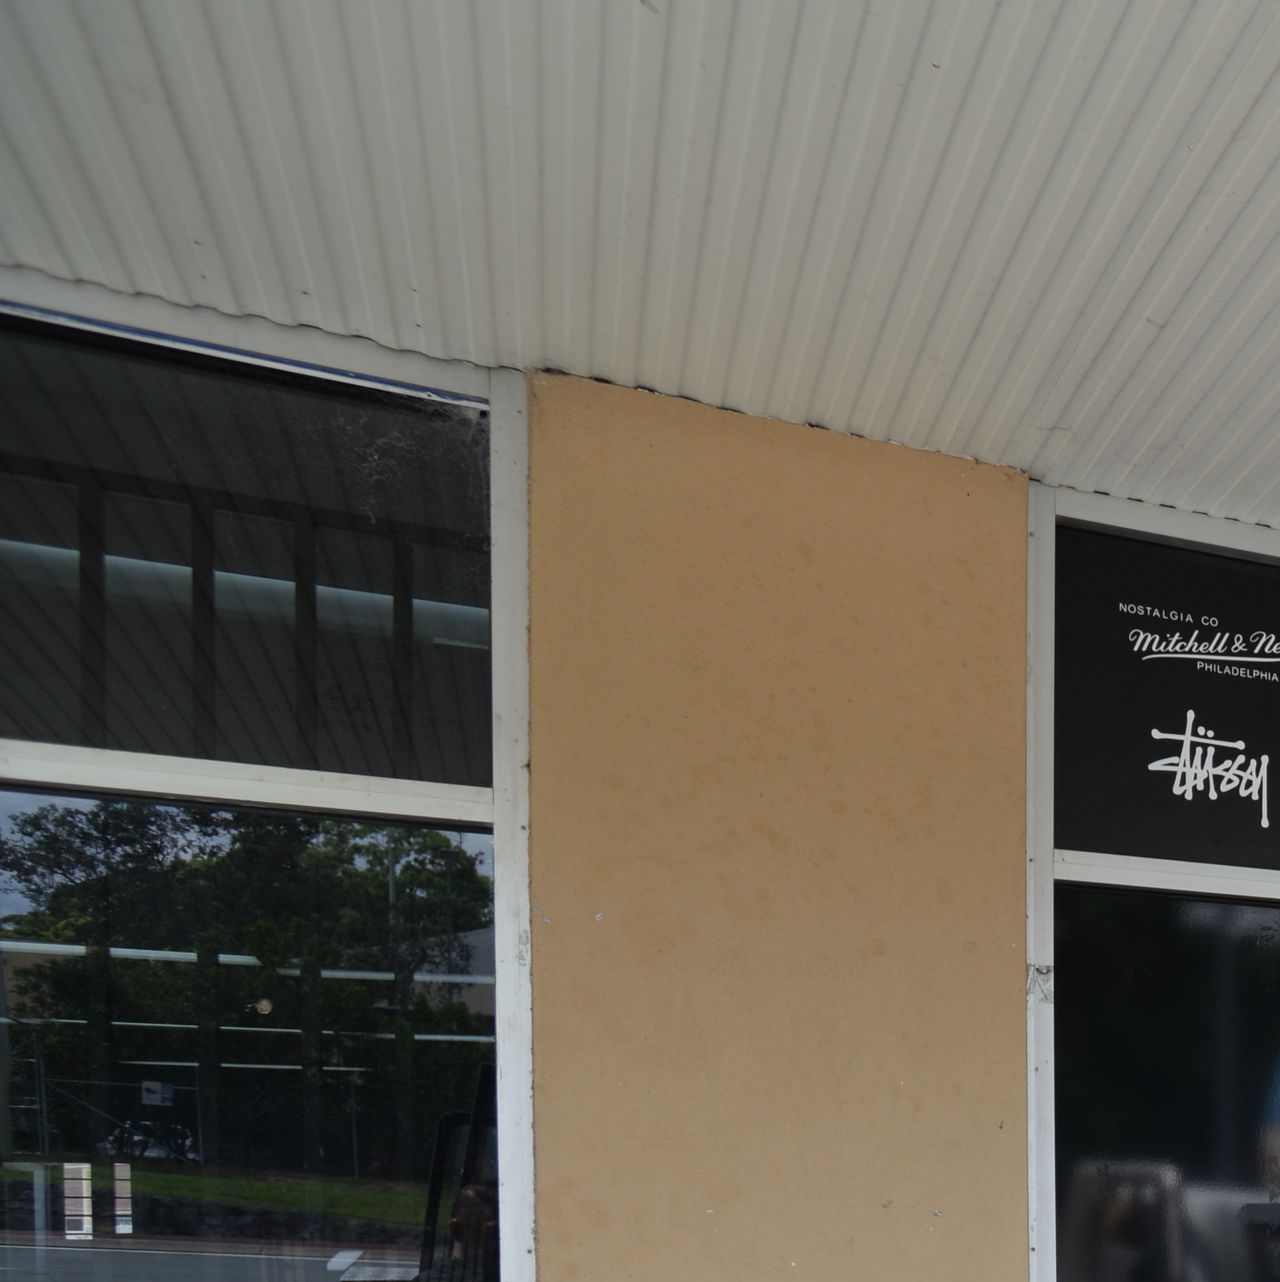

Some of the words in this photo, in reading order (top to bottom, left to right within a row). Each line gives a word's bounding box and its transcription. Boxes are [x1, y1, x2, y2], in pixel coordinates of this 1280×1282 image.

[1118, 602, 1194, 624] NOSTALGIA
[1200, 615, 1219, 628] CO
[1128, 628, 1230, 655] Mitchell
[1230, 633, 1248, 652] &
